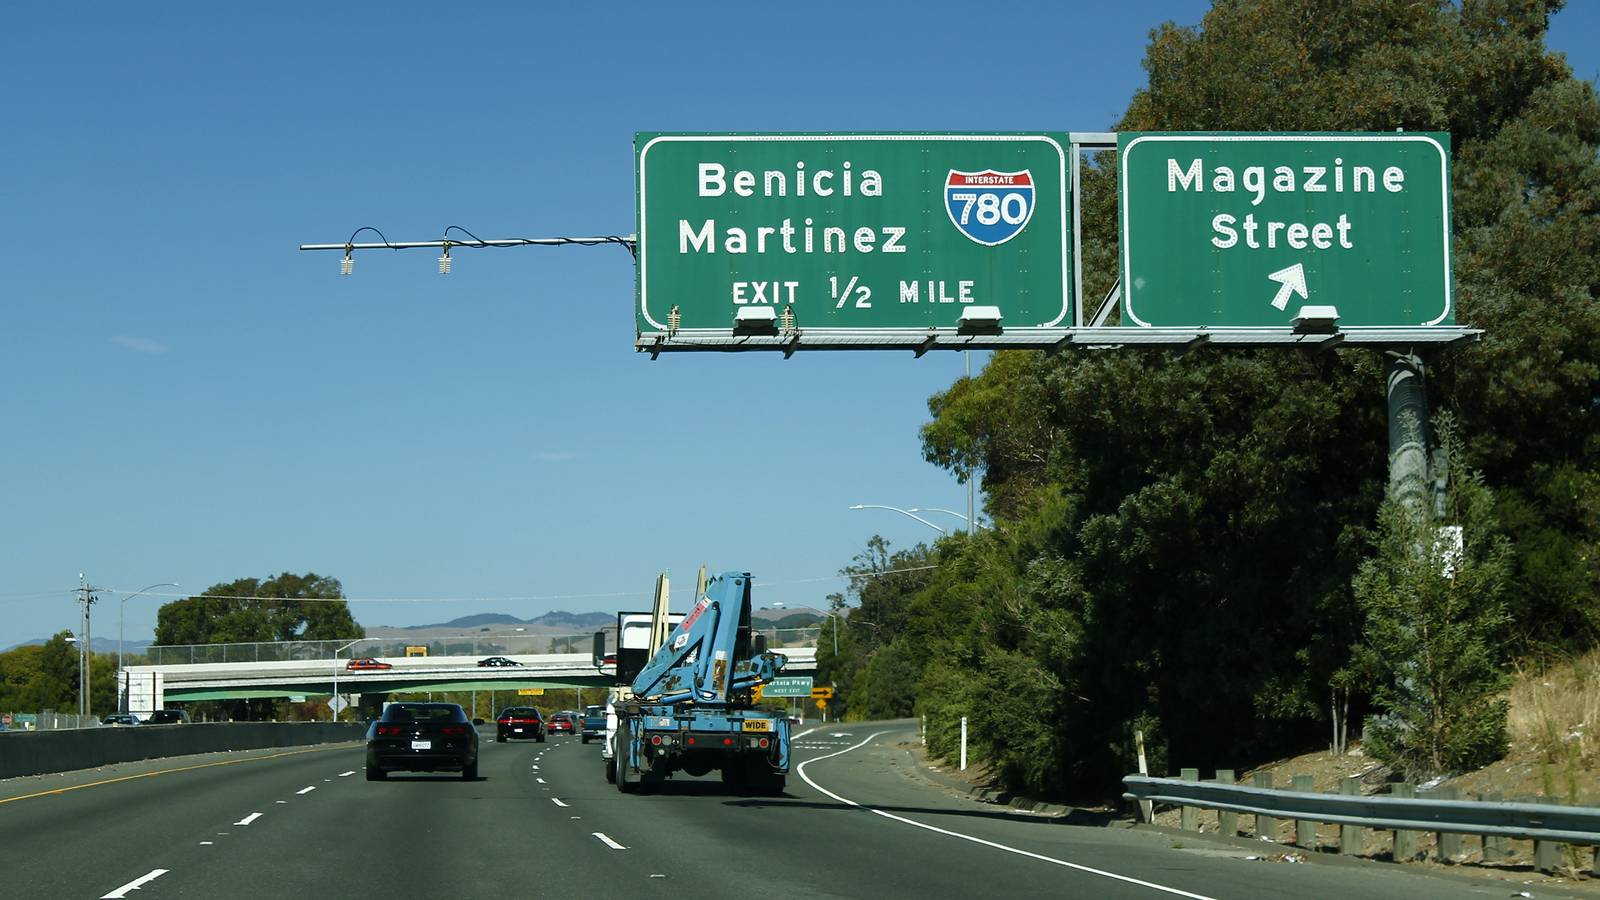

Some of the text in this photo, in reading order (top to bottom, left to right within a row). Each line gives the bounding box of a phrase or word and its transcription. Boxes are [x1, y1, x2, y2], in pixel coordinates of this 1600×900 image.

[698, 161, 883, 197] Benicia
[965, 176, 1014, 184] INTERSTATE
[1167, 157, 1405, 206] Magazine
[952, 193, 1027, 225] 780
[679, 217, 906, 253] Martinez
[1211, 213, 1353, 250] Street
[733, 281, 799, 304] EXIT
[899, 280, 974, 303] MILE
[745, 721, 767, 730] WIDE
